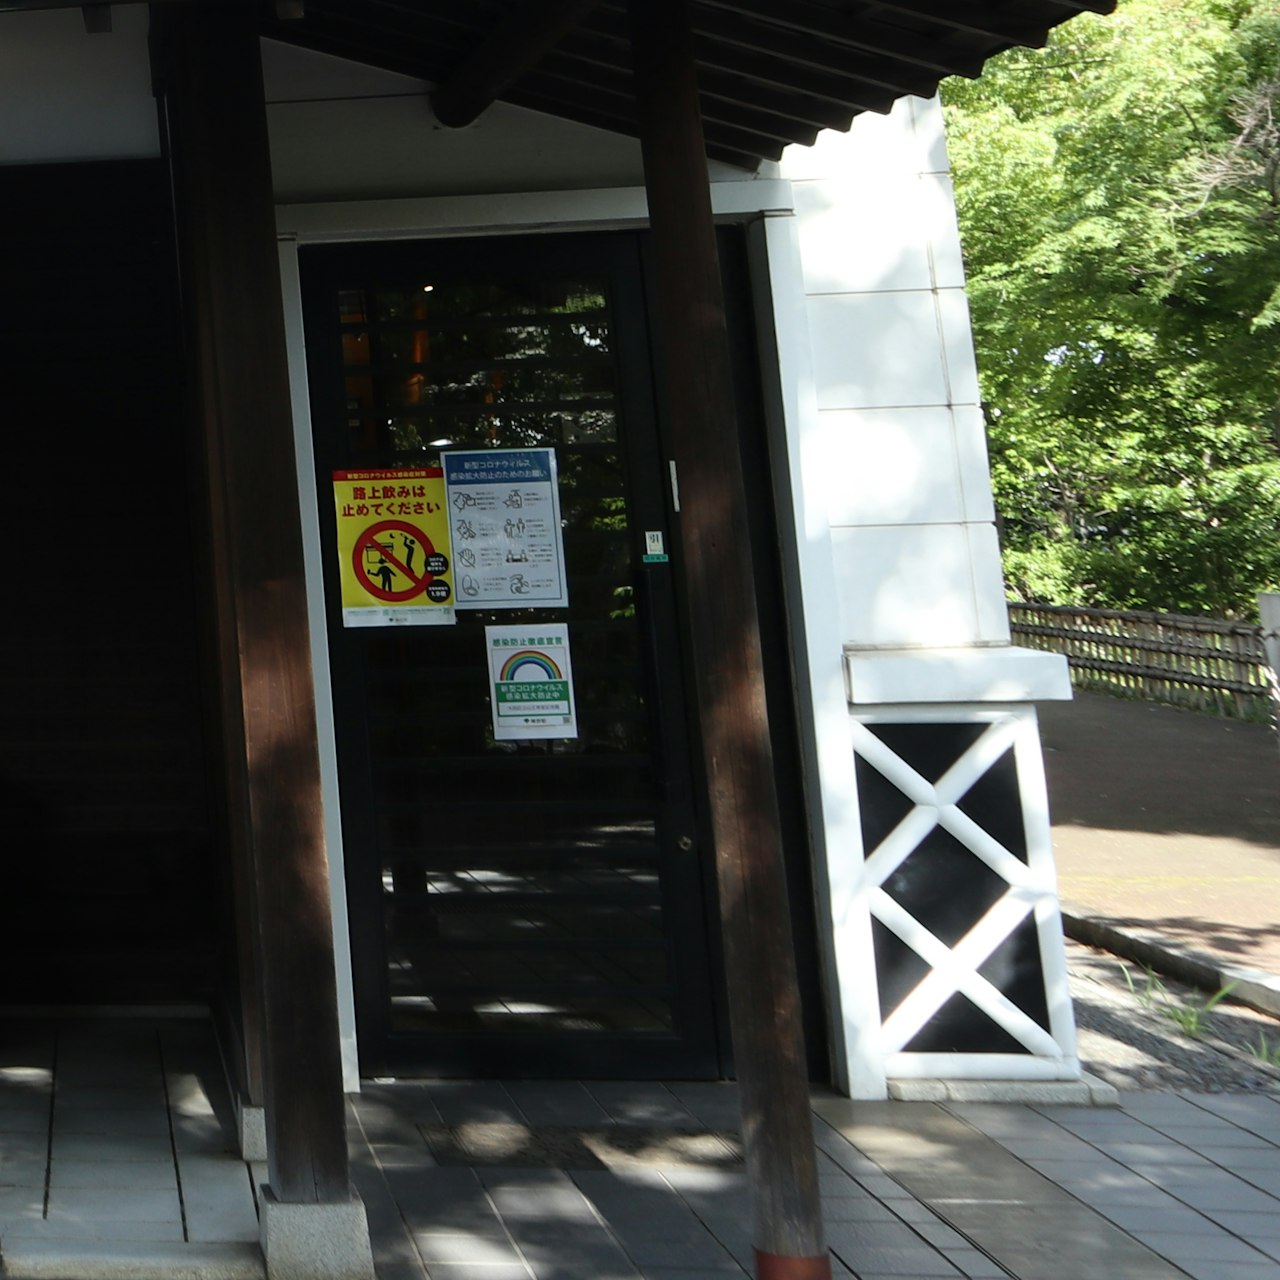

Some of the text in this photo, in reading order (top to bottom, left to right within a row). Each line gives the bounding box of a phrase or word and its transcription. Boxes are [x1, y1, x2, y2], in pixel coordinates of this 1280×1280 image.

[353, 485, 425, 500] 路上飲みは
[342, 502, 440, 517] 止めてください
